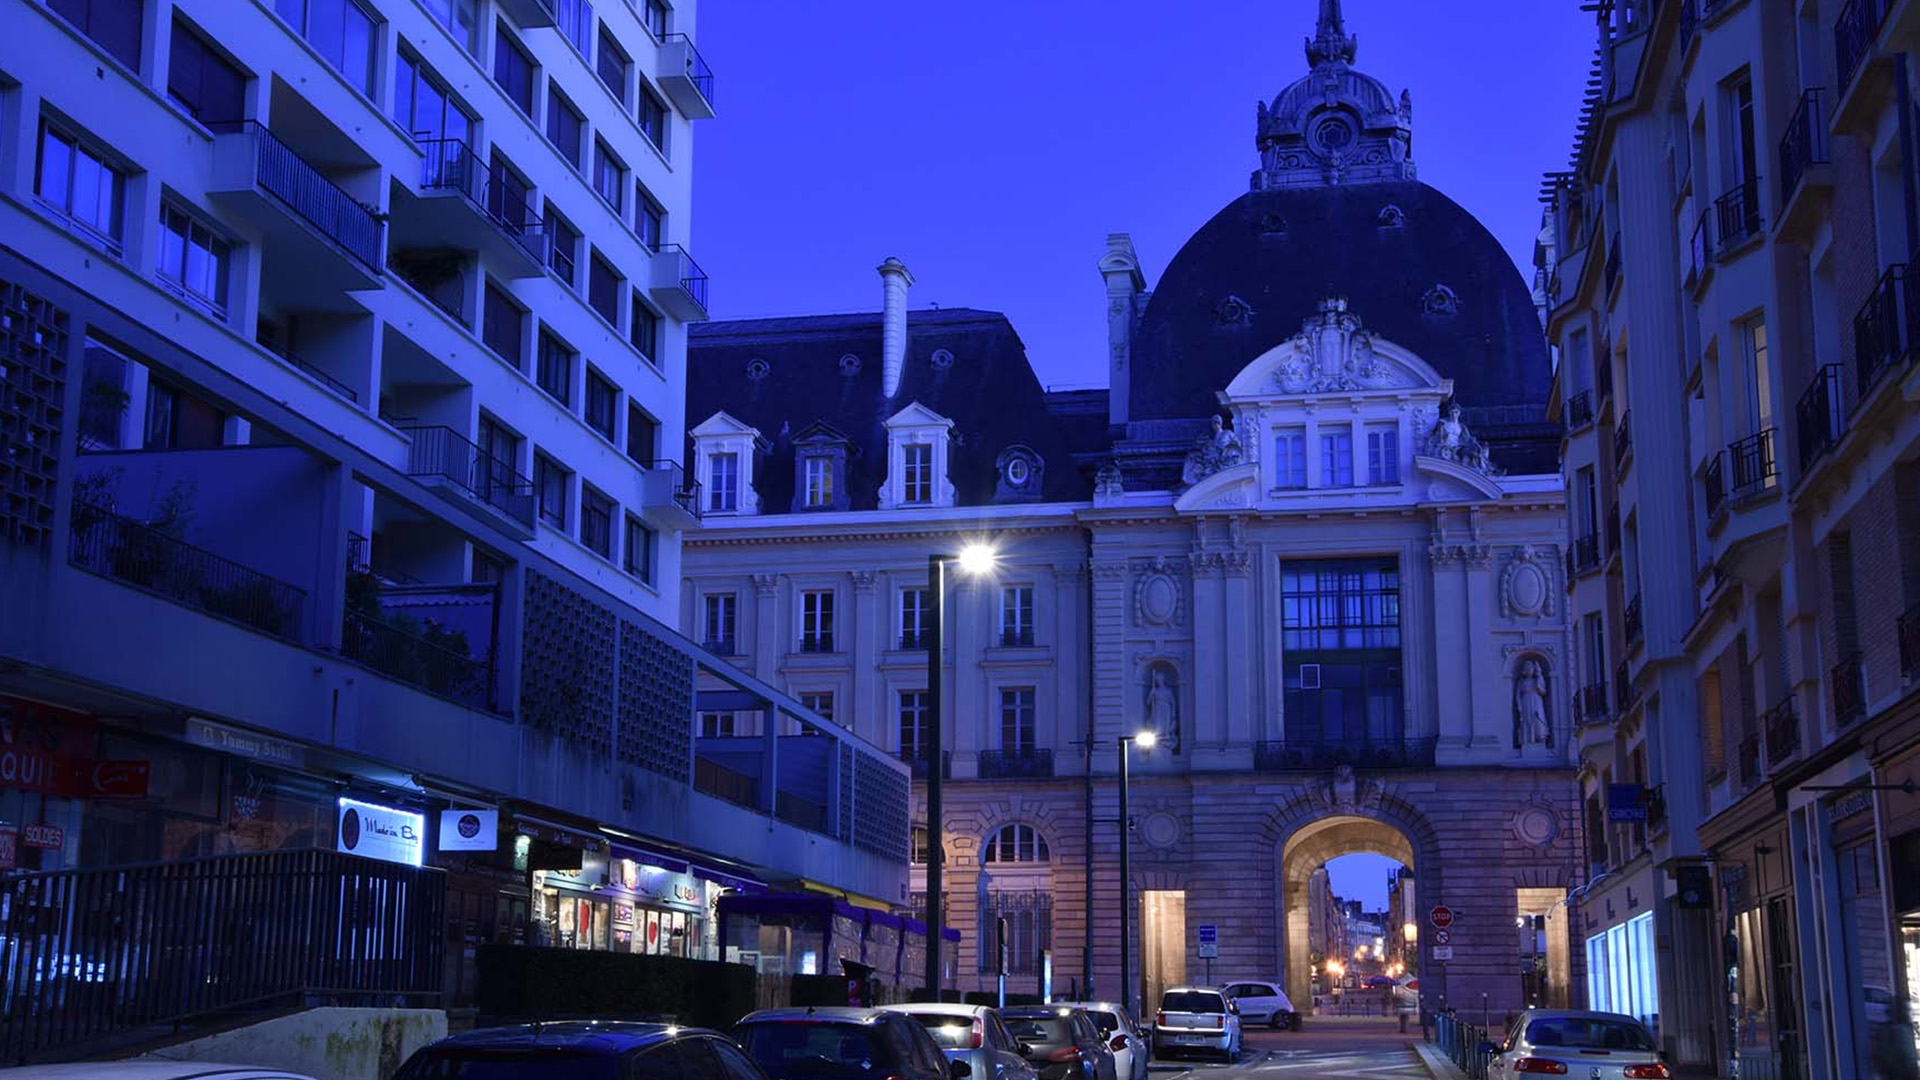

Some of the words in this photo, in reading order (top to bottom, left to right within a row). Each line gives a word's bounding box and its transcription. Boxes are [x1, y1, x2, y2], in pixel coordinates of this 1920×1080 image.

[220, 730, 260, 757] Yummy
[25, 826, 62, 846] SOLDES
[364, 816, 389, 836] Made
[389, 825, 398, 837] in
[1432, 912, 1451, 921] STOP
